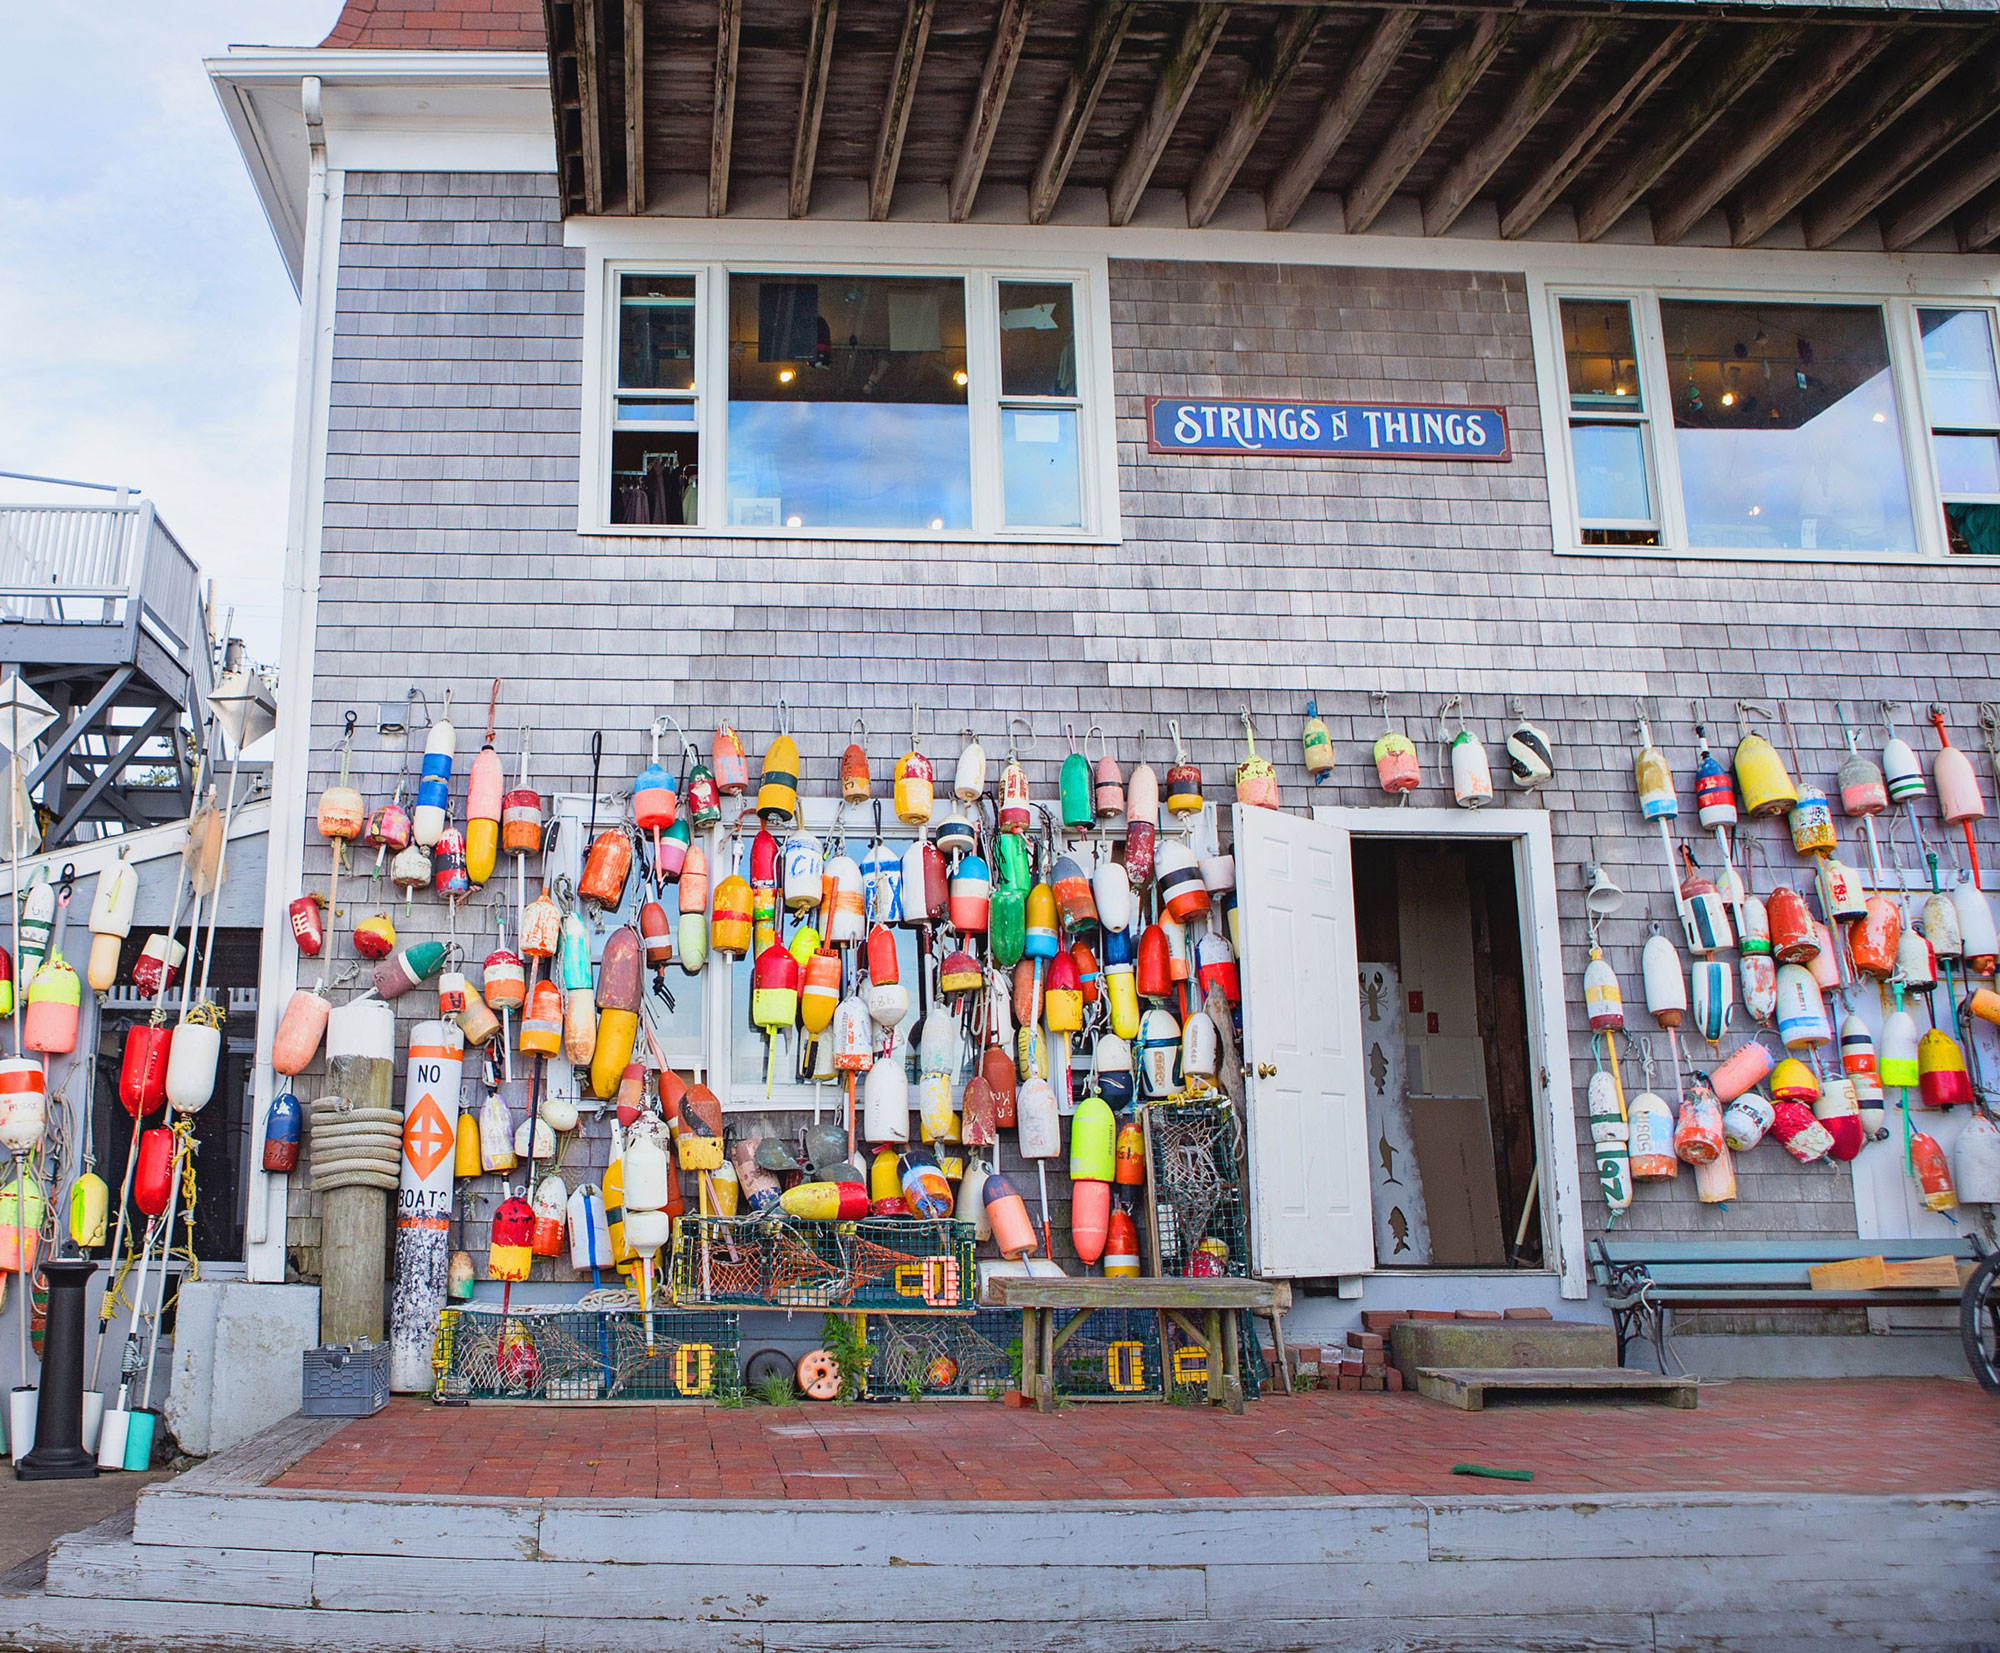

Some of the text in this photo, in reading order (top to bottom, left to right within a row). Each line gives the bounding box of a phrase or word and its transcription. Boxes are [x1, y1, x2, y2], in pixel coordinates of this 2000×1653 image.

[1174, 405, 1320, 449] STRINGS
[1363, 410, 1487, 448] THINGS
[418, 1064, 441, 1083] NO
